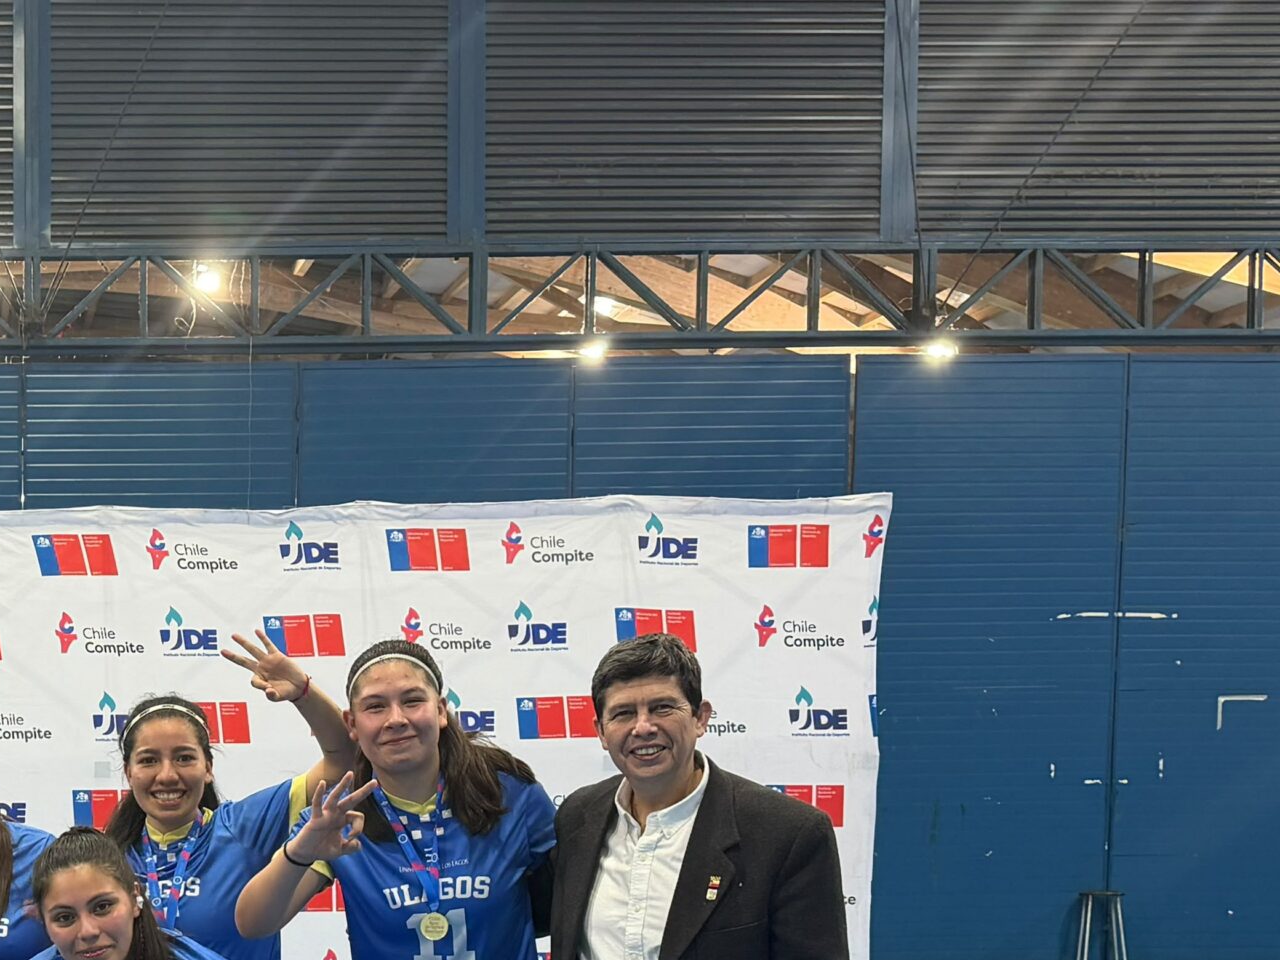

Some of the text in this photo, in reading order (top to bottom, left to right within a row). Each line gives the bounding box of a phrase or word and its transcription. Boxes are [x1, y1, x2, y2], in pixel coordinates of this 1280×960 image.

[530, 535, 565, 548] Chile
[174, 543, 208, 556] Chile
[531, 550, 594, 565] Compite
[177, 558, 238, 573] Compite
[429, 623, 463, 635] Chile
[783, 620, 817, 633] Chile
[82, 628, 116, 640] Chile
[85, 642, 144, 656] Compite
[431, 637, 492, 653] Compite
[784, 635, 845, 650] Compite
[705, 721, 746, 736] mpite
